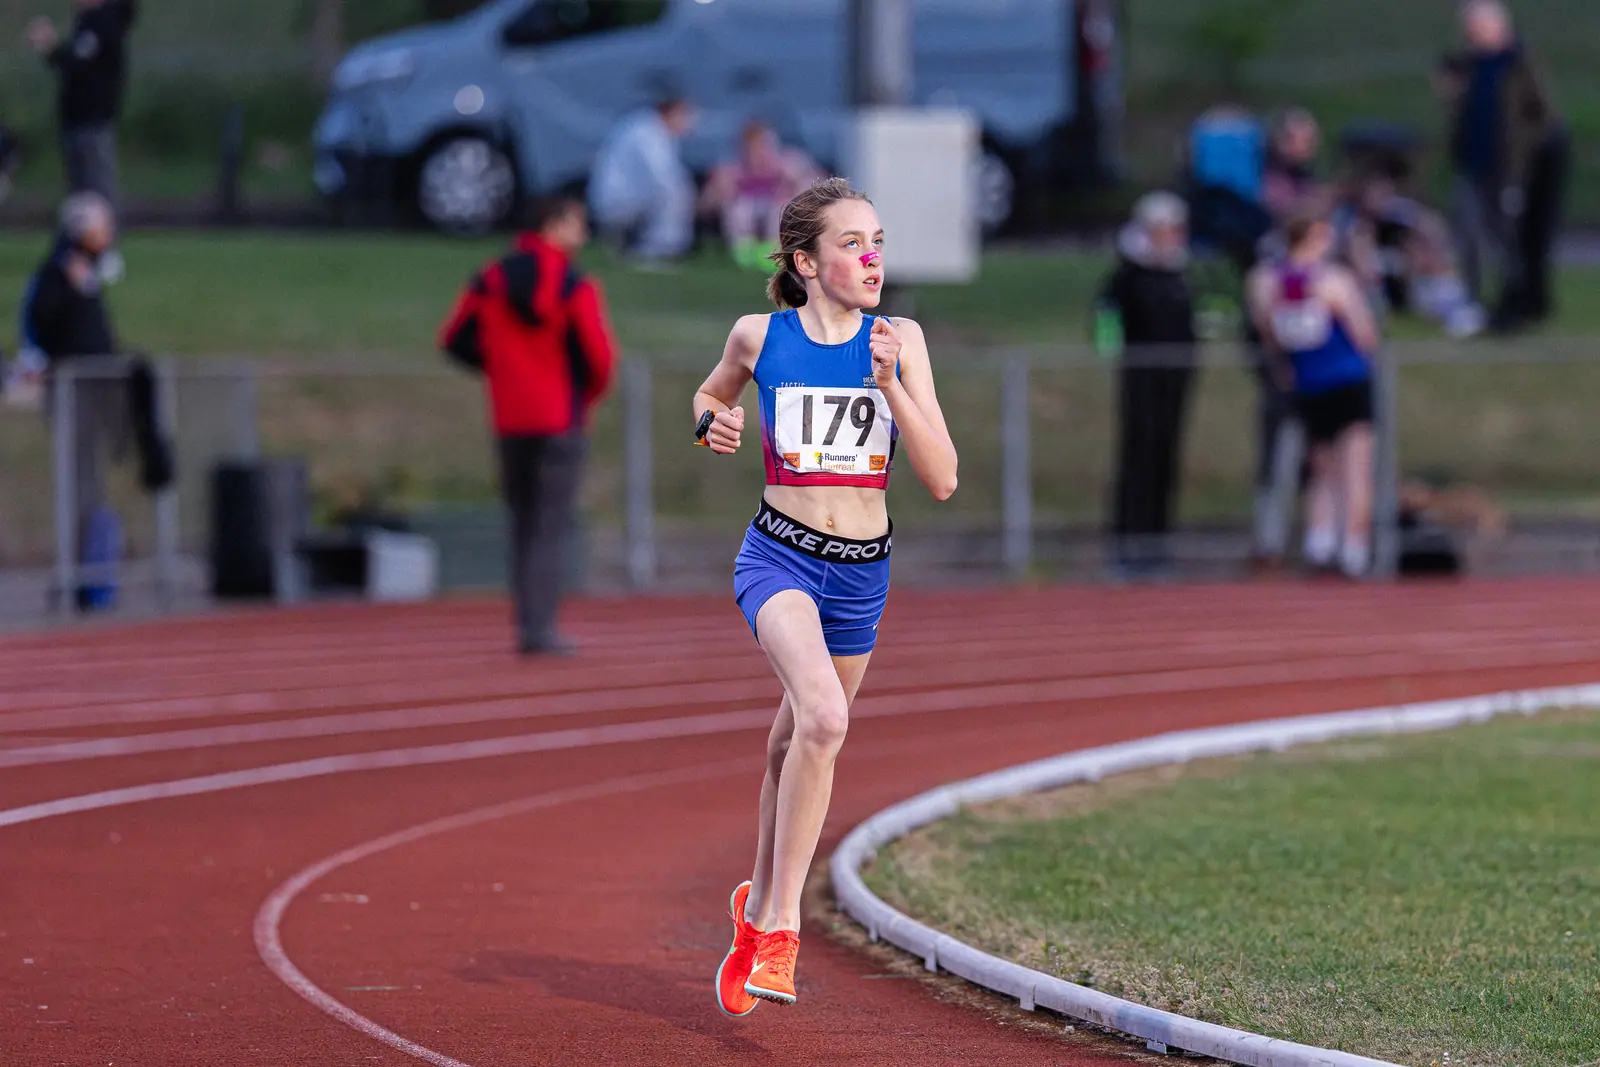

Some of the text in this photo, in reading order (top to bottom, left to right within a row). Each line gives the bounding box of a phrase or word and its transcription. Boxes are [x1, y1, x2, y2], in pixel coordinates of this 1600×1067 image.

[802, 394, 876, 447] 179
[824, 452, 858, 462] Runners'
[758, 511, 823, 552] NIKE
[821, 540, 880, 559] PRO
